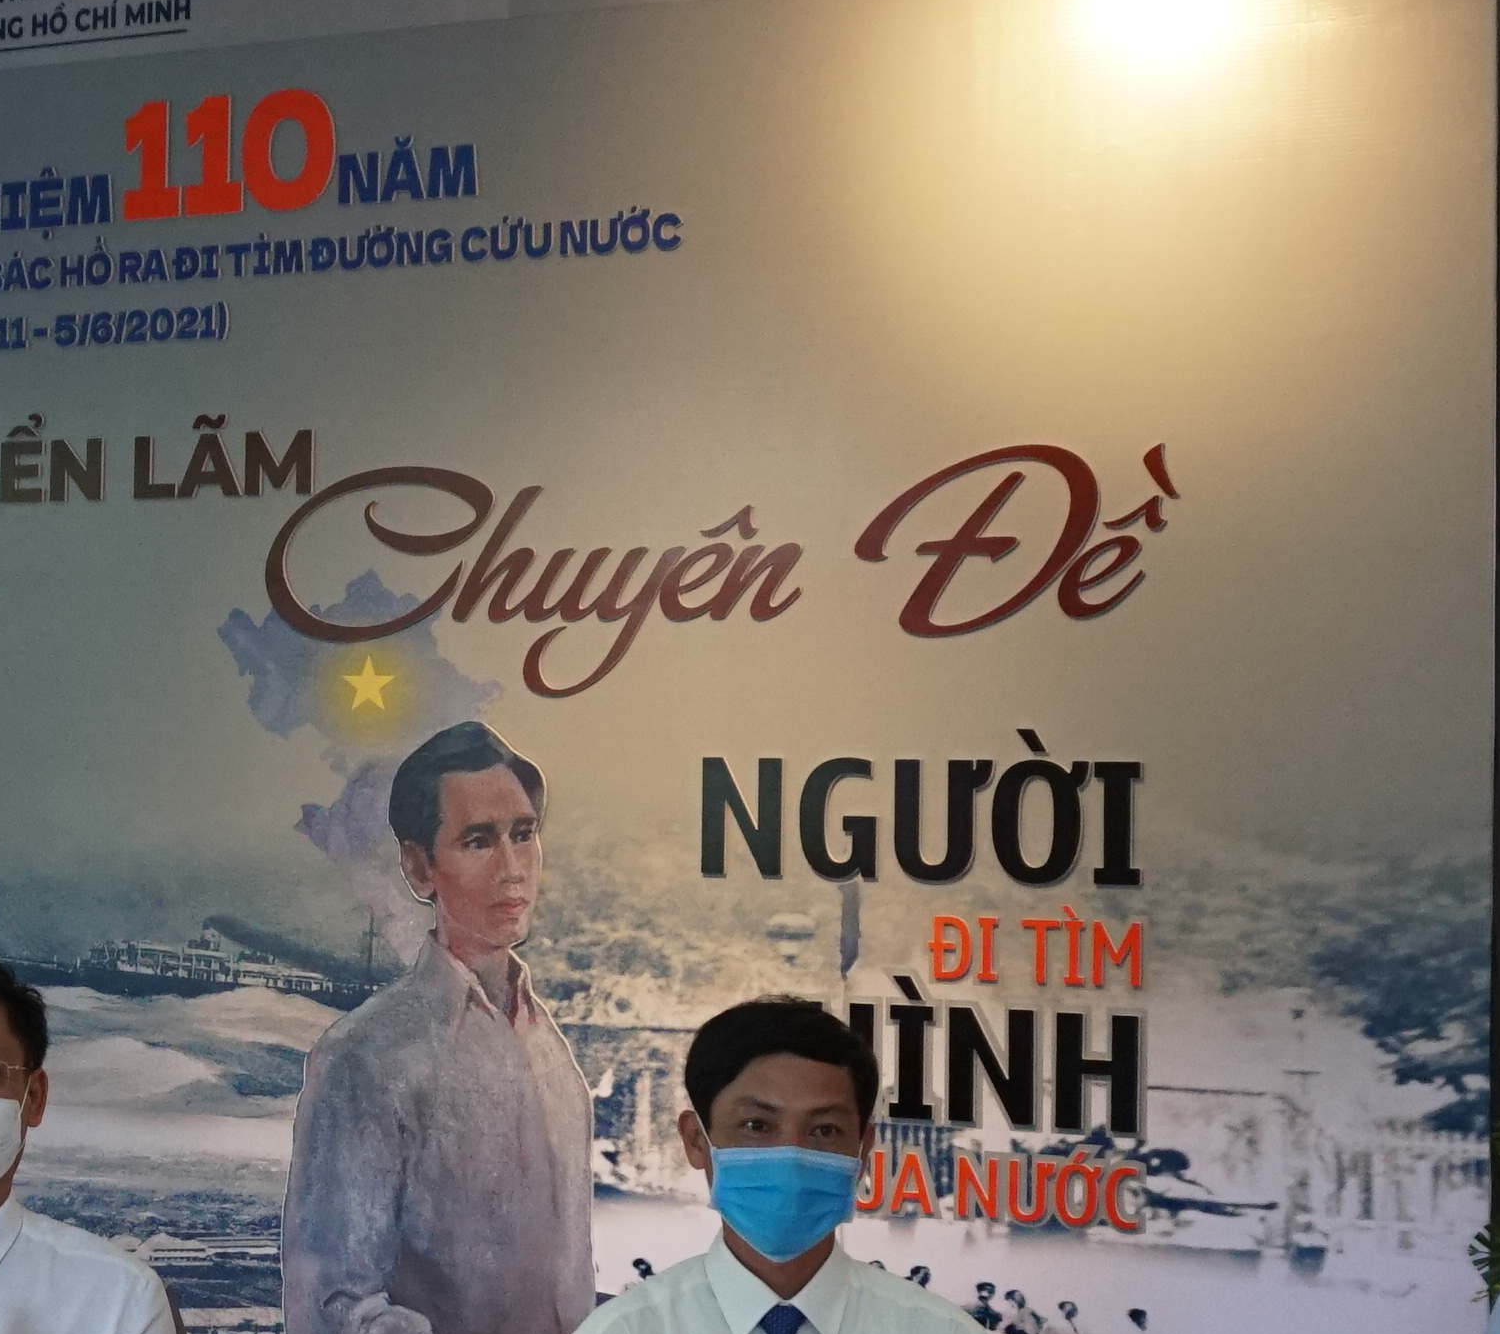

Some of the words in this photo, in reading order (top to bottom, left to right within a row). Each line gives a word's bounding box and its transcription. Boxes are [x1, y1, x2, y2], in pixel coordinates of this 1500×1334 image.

[31, 3, 67, 37] HỒ
[75, 2, 118, 31] CHÍ
[122, 88, 337, 221] 110
[338, 134, 478, 207] NĂM
[61, 236, 113, 288] HỒ
[118, 247, 170, 285] RA
[172, 243, 219, 280] ĐI
[228, 232, 304, 275] TÌM
[309, 223, 453, 273] ĐƯỜNG
[459, 213, 553, 262] CỨU
[559, 204, 684, 257] NƯỚC
[54, 301, 230, 347] 5/6/2021)
[133, 413, 317, 503] LÃM
[265, 465, 805, 699] Chuyên
[854, 441, 1183, 639] Đề
[701, 728, 1143, 887] NGƯỜI
[928, 914, 998, 983] ĐI
[1021, 905, 1143, 988] TÌM
[957, 1149, 1139, 1231] NƯỚC
